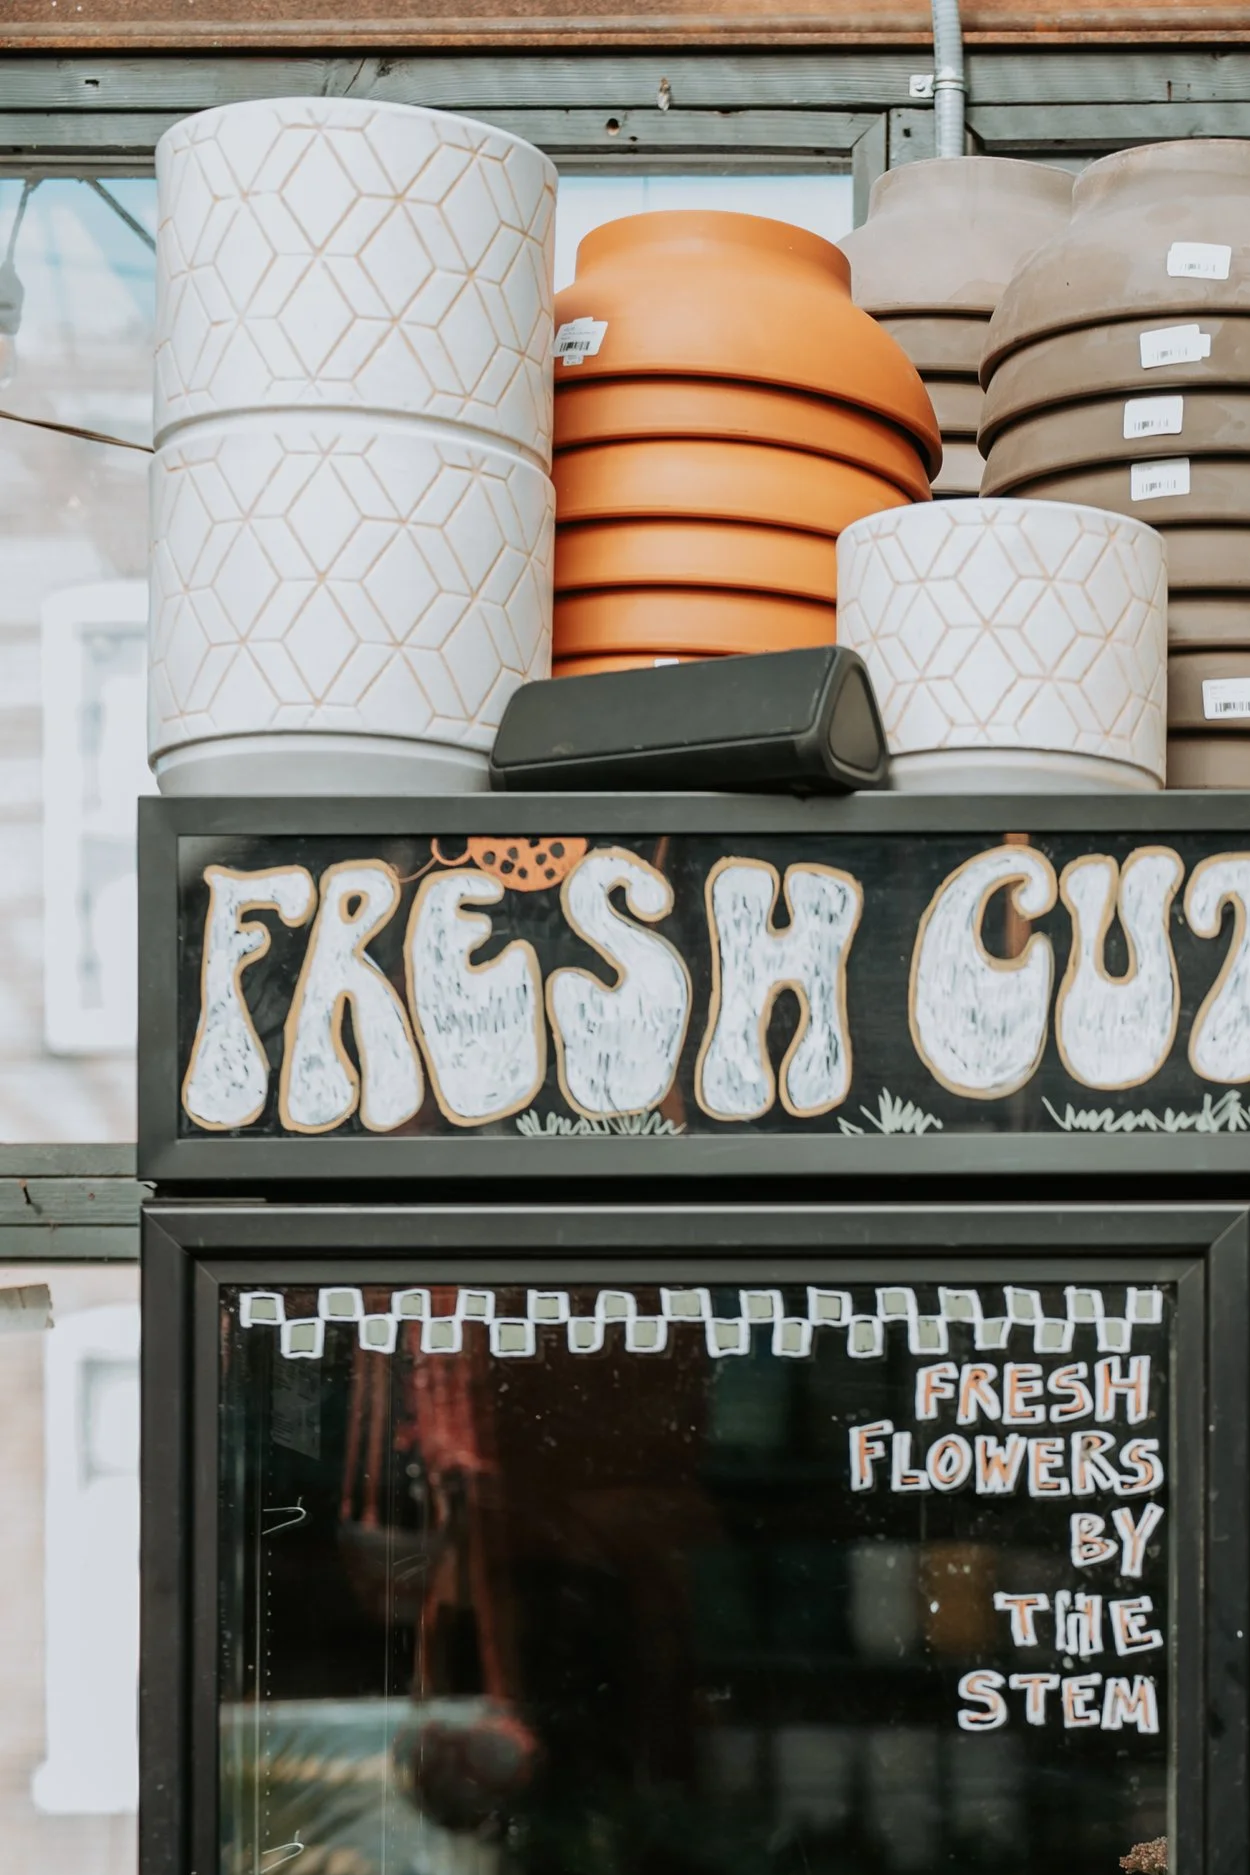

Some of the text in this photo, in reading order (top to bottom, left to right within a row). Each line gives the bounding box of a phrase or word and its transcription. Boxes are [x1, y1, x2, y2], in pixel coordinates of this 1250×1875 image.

[184, 846, 864, 1132] FRESH
[914, 1354, 1152, 1425] FRESH
[848, 1419, 1165, 1499] FLOWERS
[1070, 1502, 1165, 1578] BY
[993, 1589, 1165, 1657] THE
[957, 1669, 1160, 1735] STEM
